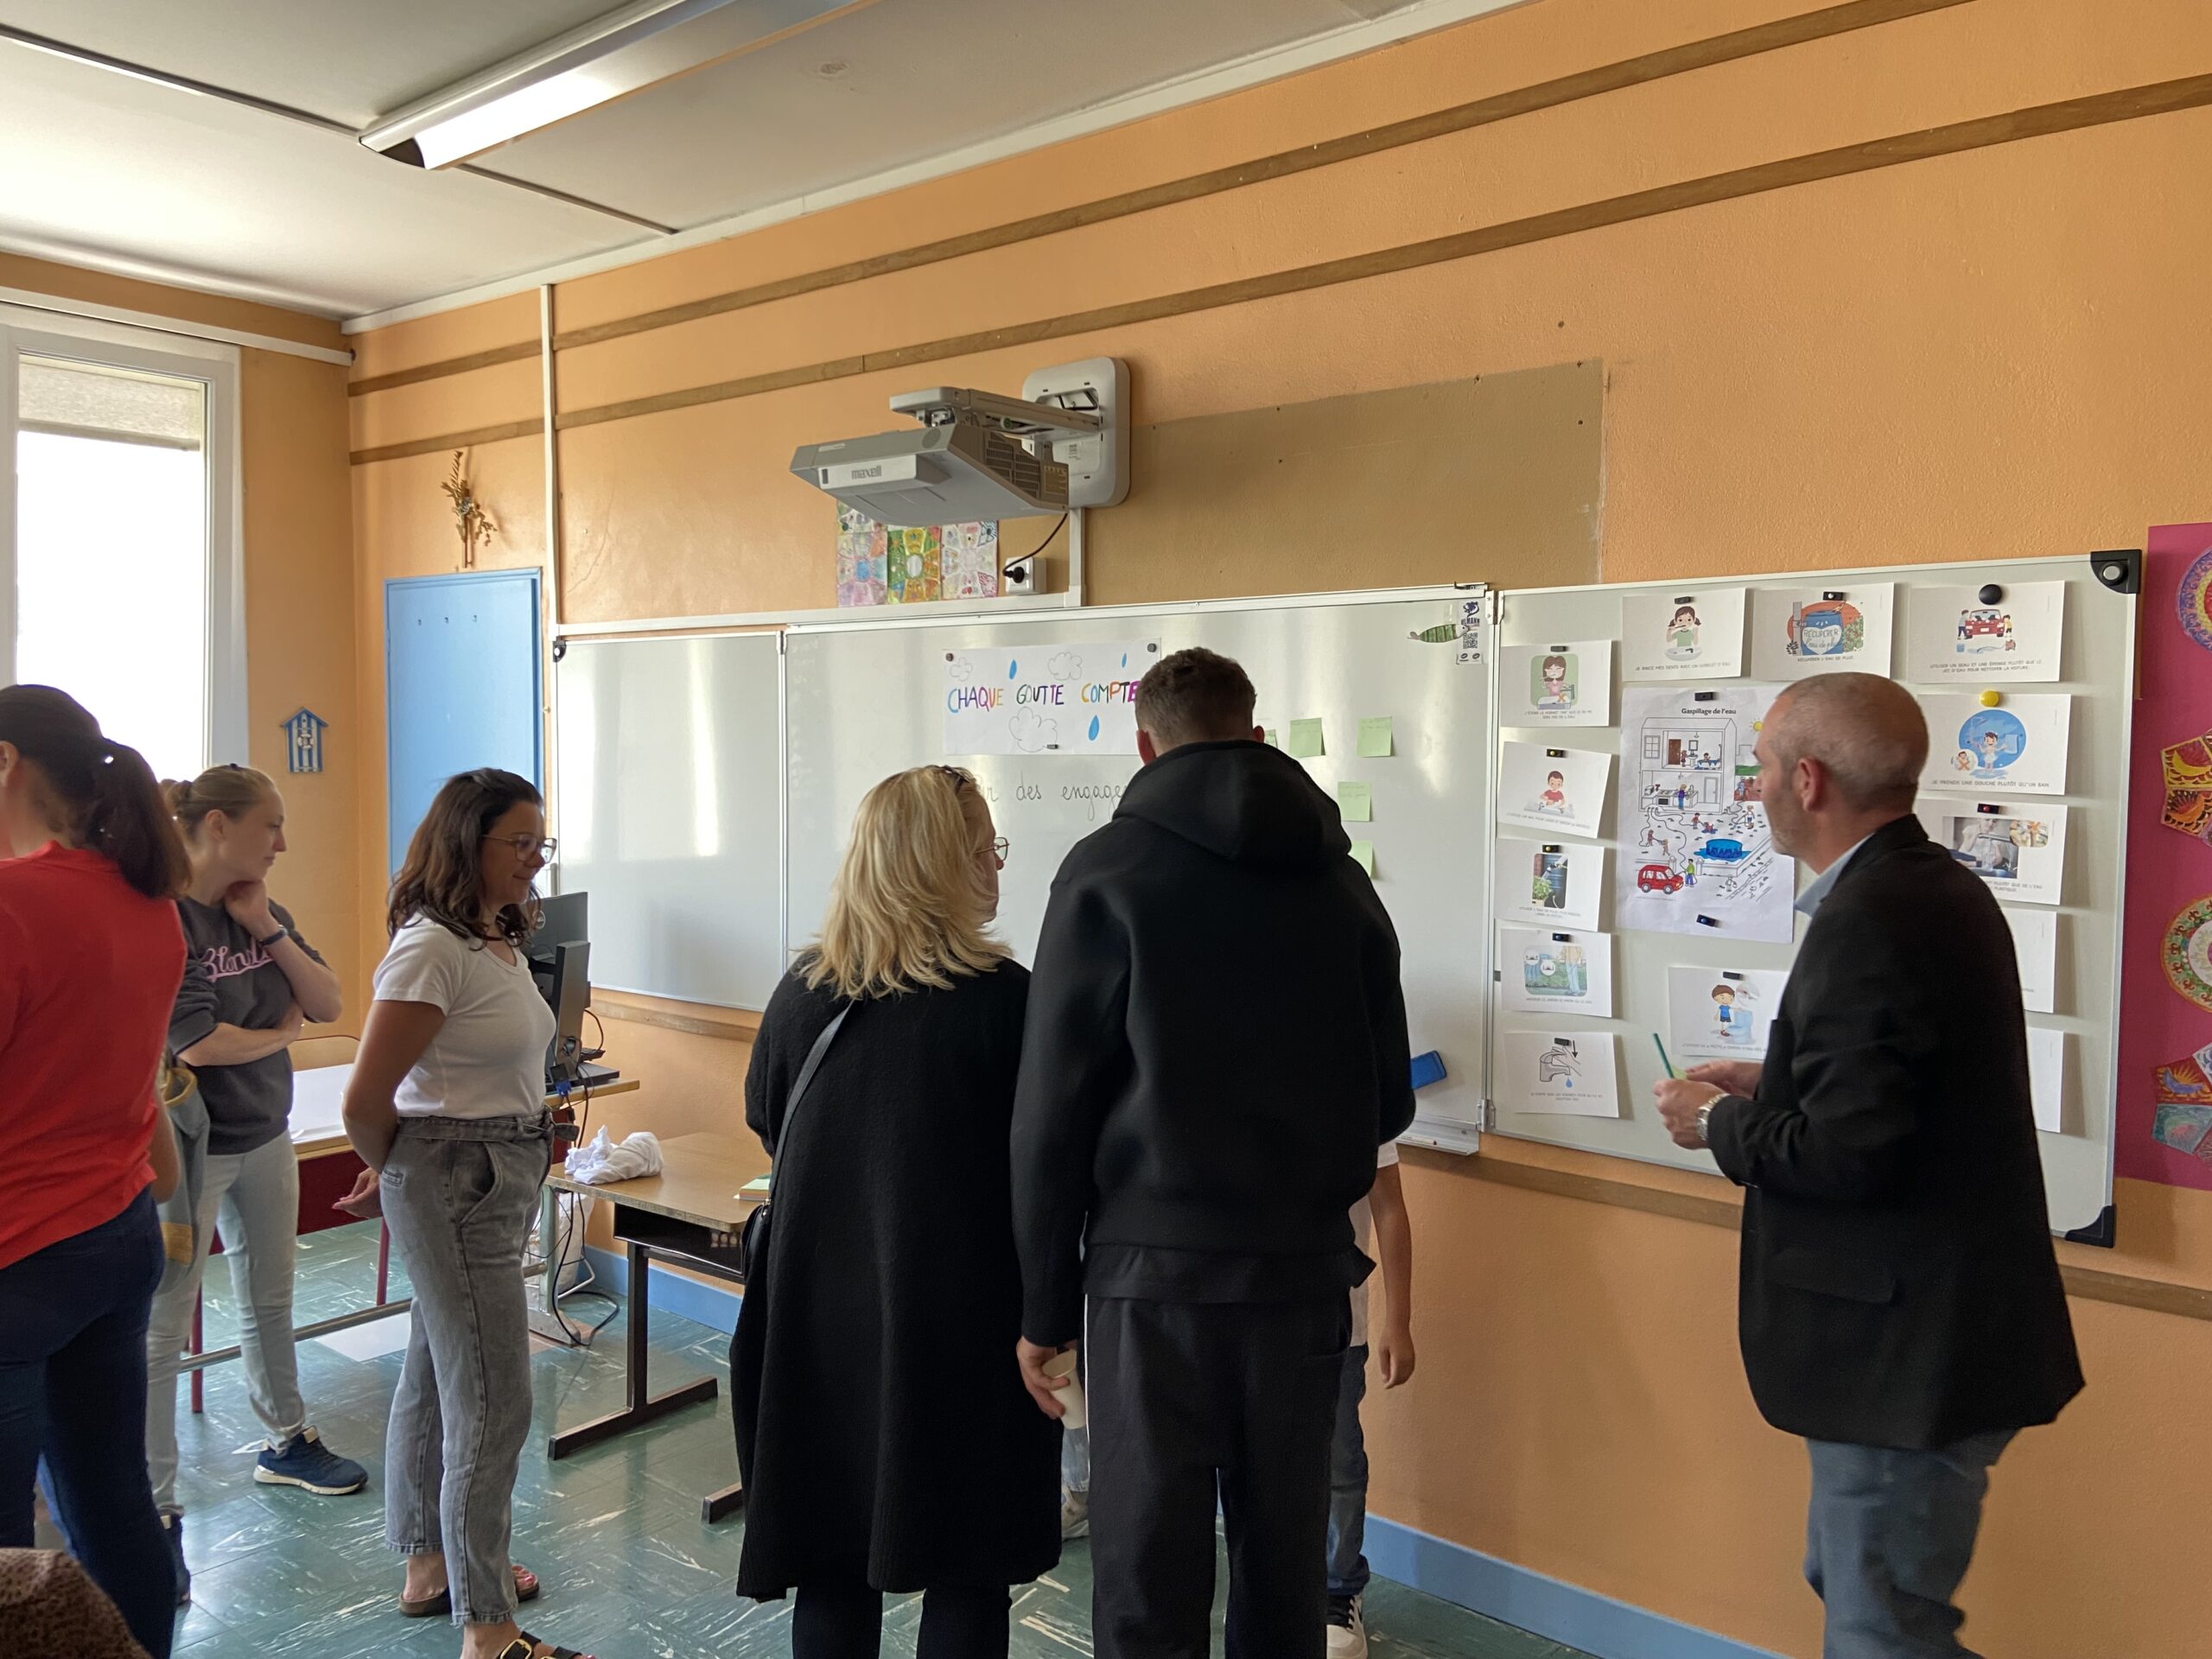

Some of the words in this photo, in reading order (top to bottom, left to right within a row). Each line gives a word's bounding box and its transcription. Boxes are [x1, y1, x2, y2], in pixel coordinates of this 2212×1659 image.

[851, 465, 881, 480] maxell
[948, 686, 1004, 713] CHAQUE
[1016, 683, 1065, 706] GOUTTE
[1082, 680, 1141, 704] COMPTE
[1015, 770, 1042, 801] des
[1061, 784, 1127, 822] engage
[201, 936, 271, 975] Blond
